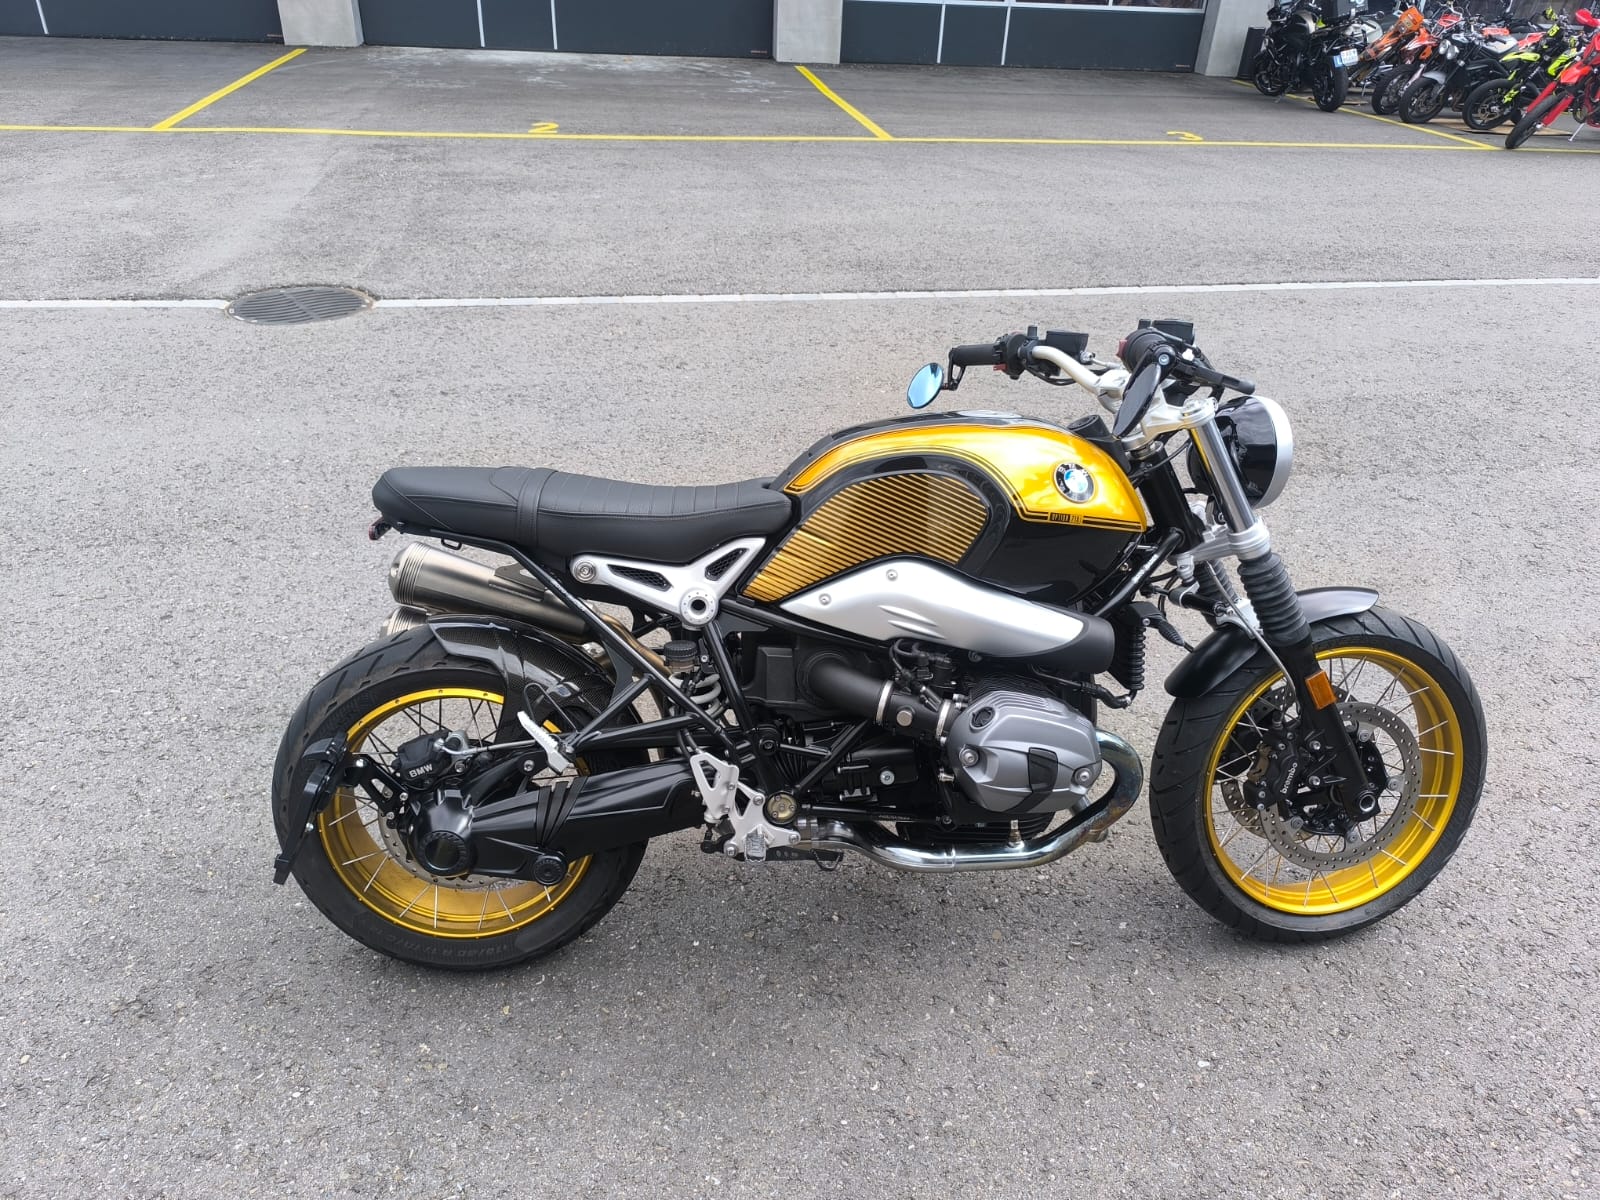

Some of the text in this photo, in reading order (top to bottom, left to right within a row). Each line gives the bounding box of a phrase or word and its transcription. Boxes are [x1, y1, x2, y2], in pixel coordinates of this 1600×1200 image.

[527, 122, 559, 134] 2
[1167, 131, 1203, 140] 3
[409, 763, 432, 778] BMW
[1280, 762, 1297, 793] brembo
